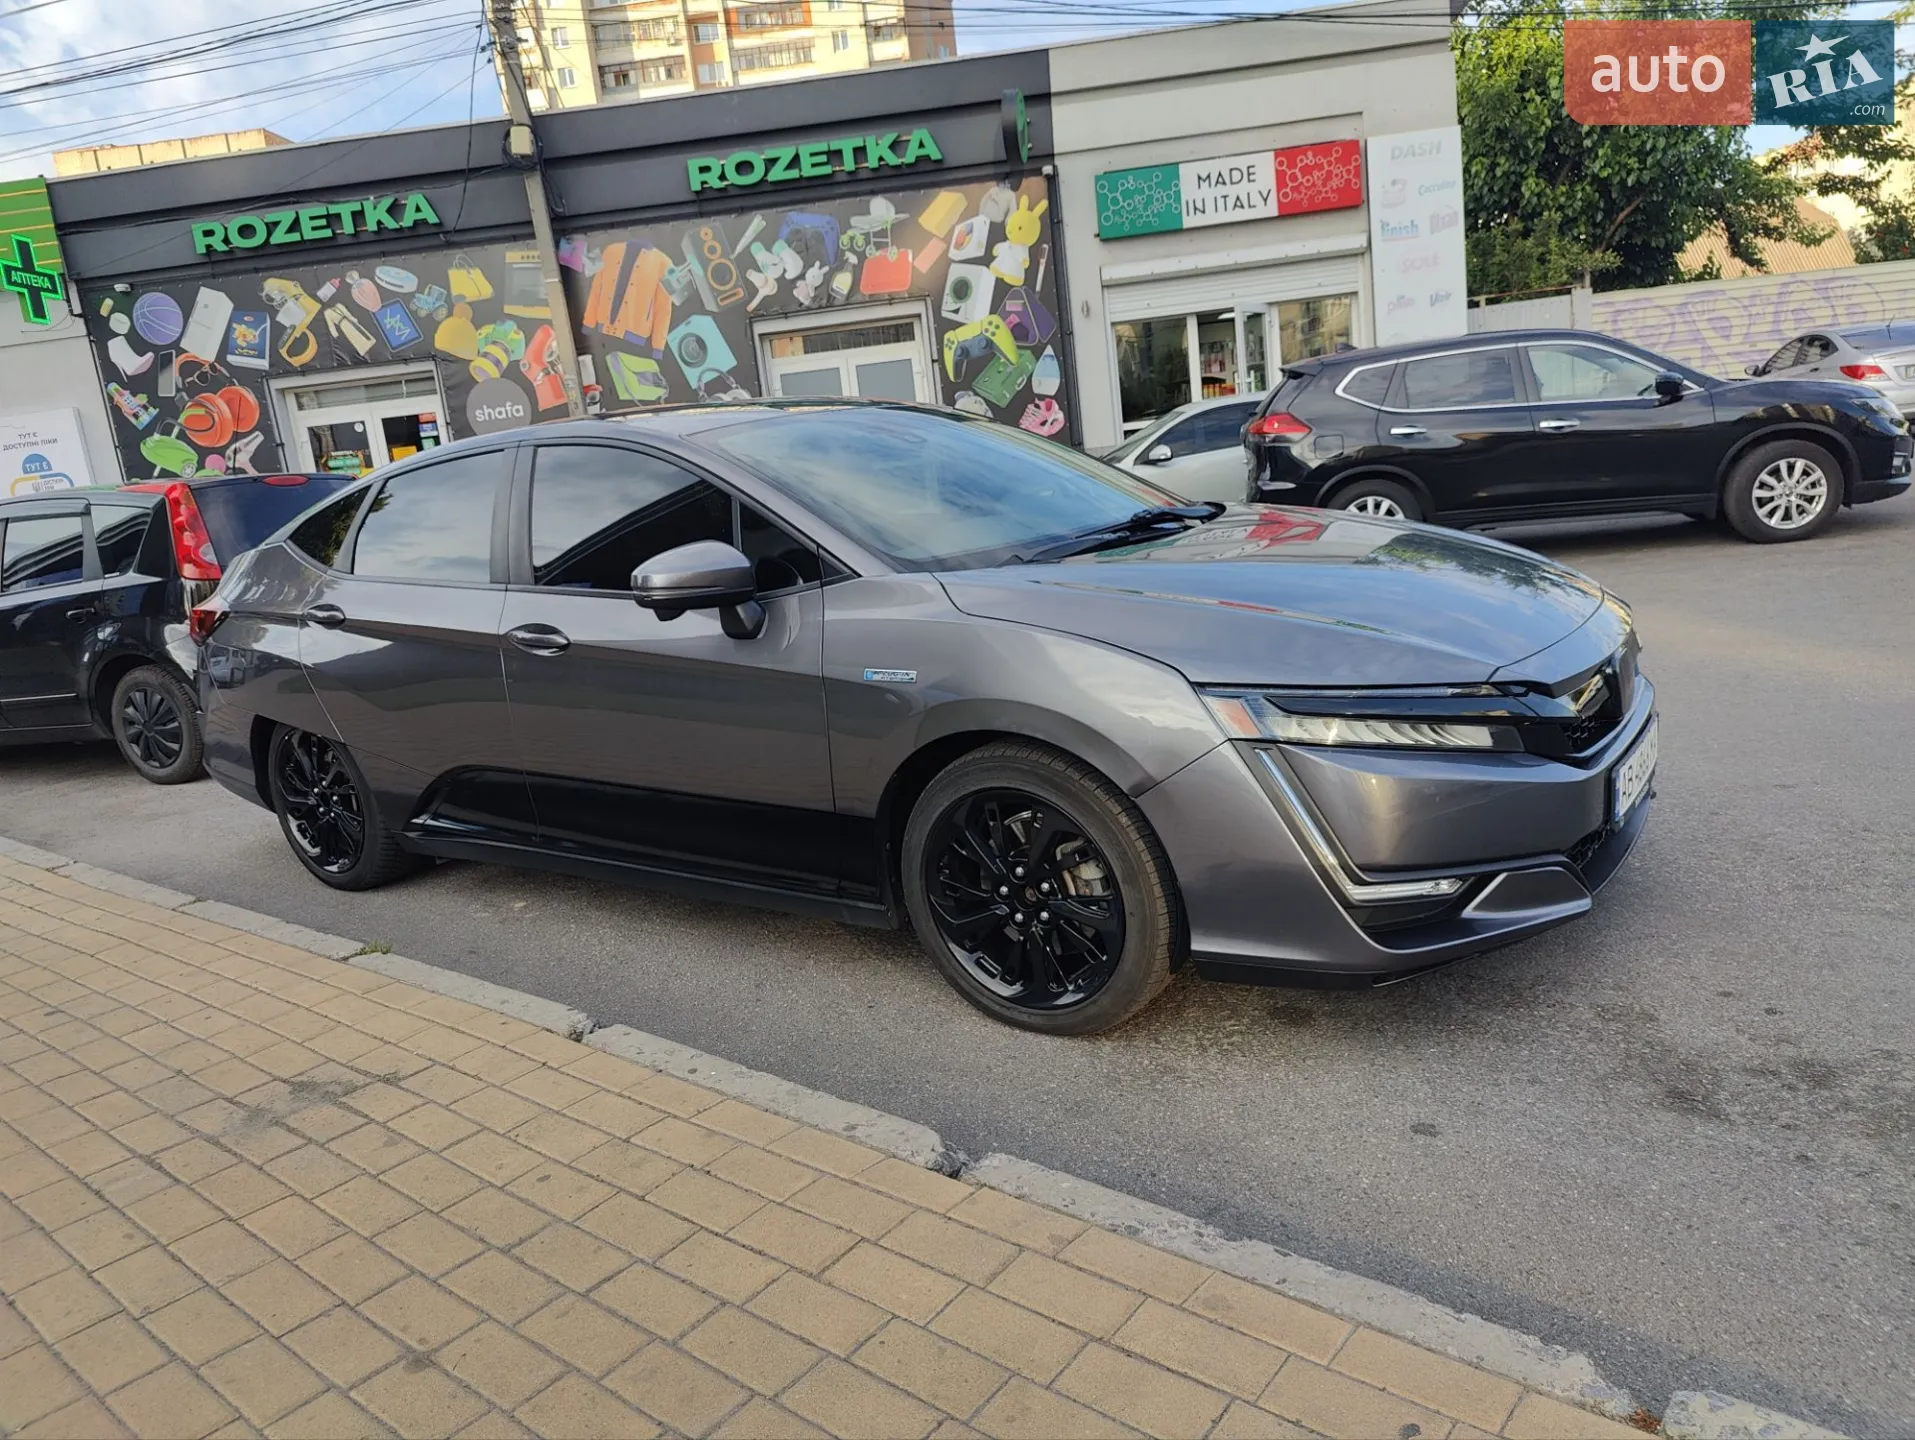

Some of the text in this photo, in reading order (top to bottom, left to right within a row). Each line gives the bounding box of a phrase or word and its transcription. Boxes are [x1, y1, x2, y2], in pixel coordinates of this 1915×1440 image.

[688, 128, 944, 192] ROZETKA
[1197, 164, 1257, 190] MADE
[1185, 188, 1272, 217] IN ITALY
[192, 192, 440, 256] ROZETKA
[11, 270, 53, 290] АПТЕКА
[475, 401, 525, 422] shafa
[25, 462, 41, 472] ТУТ
